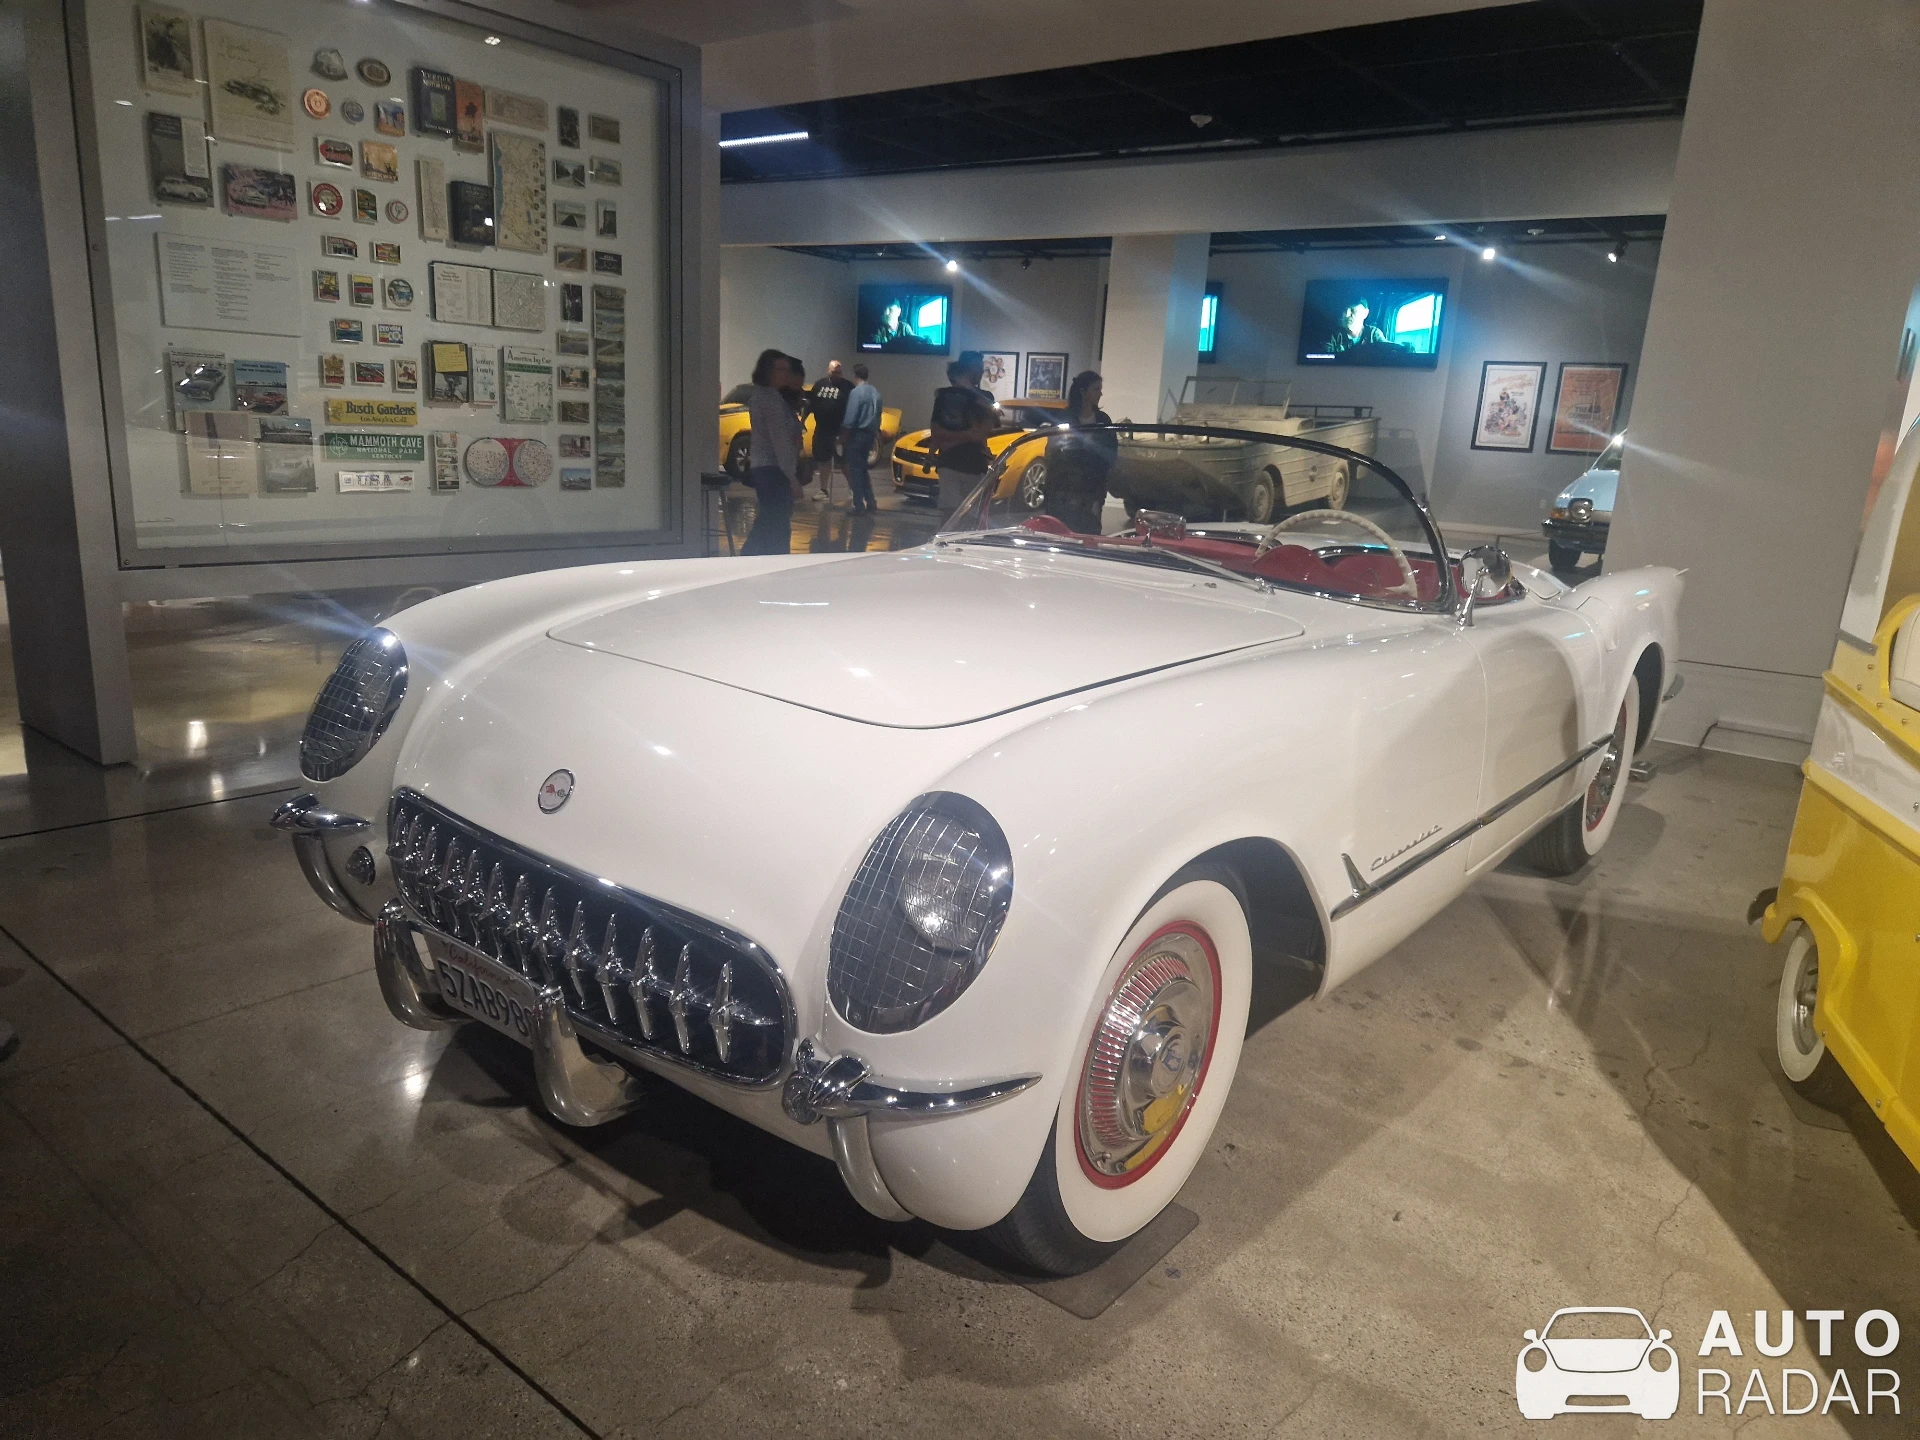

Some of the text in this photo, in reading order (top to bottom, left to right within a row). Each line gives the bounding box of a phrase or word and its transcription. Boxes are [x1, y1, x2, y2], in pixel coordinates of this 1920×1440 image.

[508, 350, 532, 362] America
[346, 401, 416, 416] Busch Gardens
[349, 435, 422, 448] MAMMOTH CAVE
